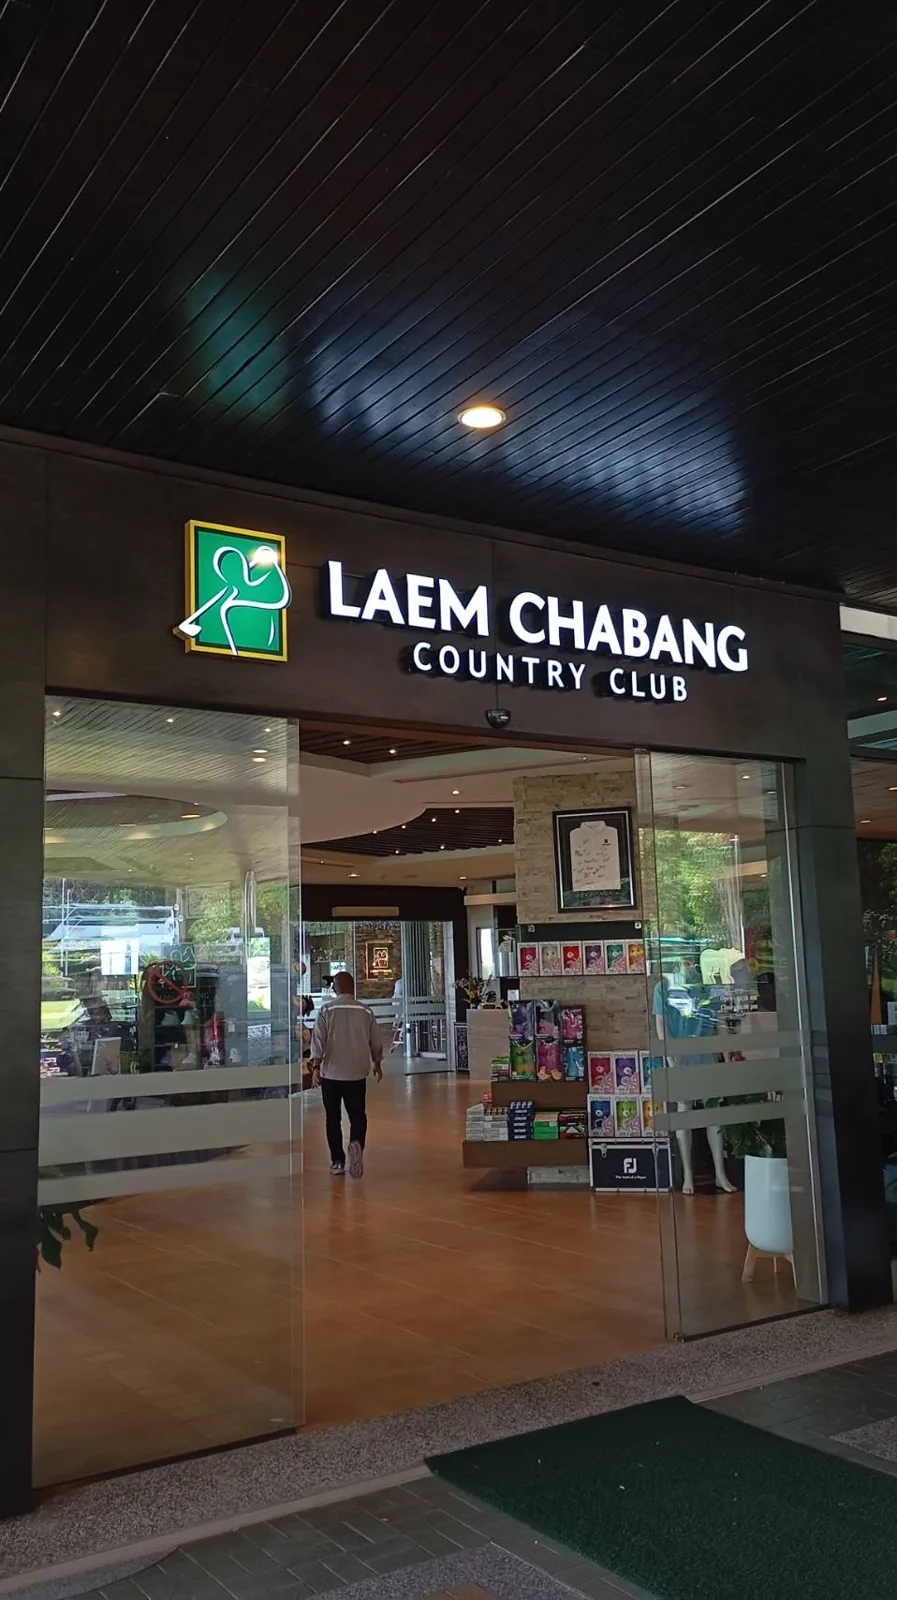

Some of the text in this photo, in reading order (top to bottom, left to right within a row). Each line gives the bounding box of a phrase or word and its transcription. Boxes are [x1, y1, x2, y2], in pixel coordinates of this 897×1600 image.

[327, 559, 749, 673] LAEM CHABANG
[412, 641, 688, 703] COUNTRY CLUB
[623, 1157, 637, 1174] FJ
